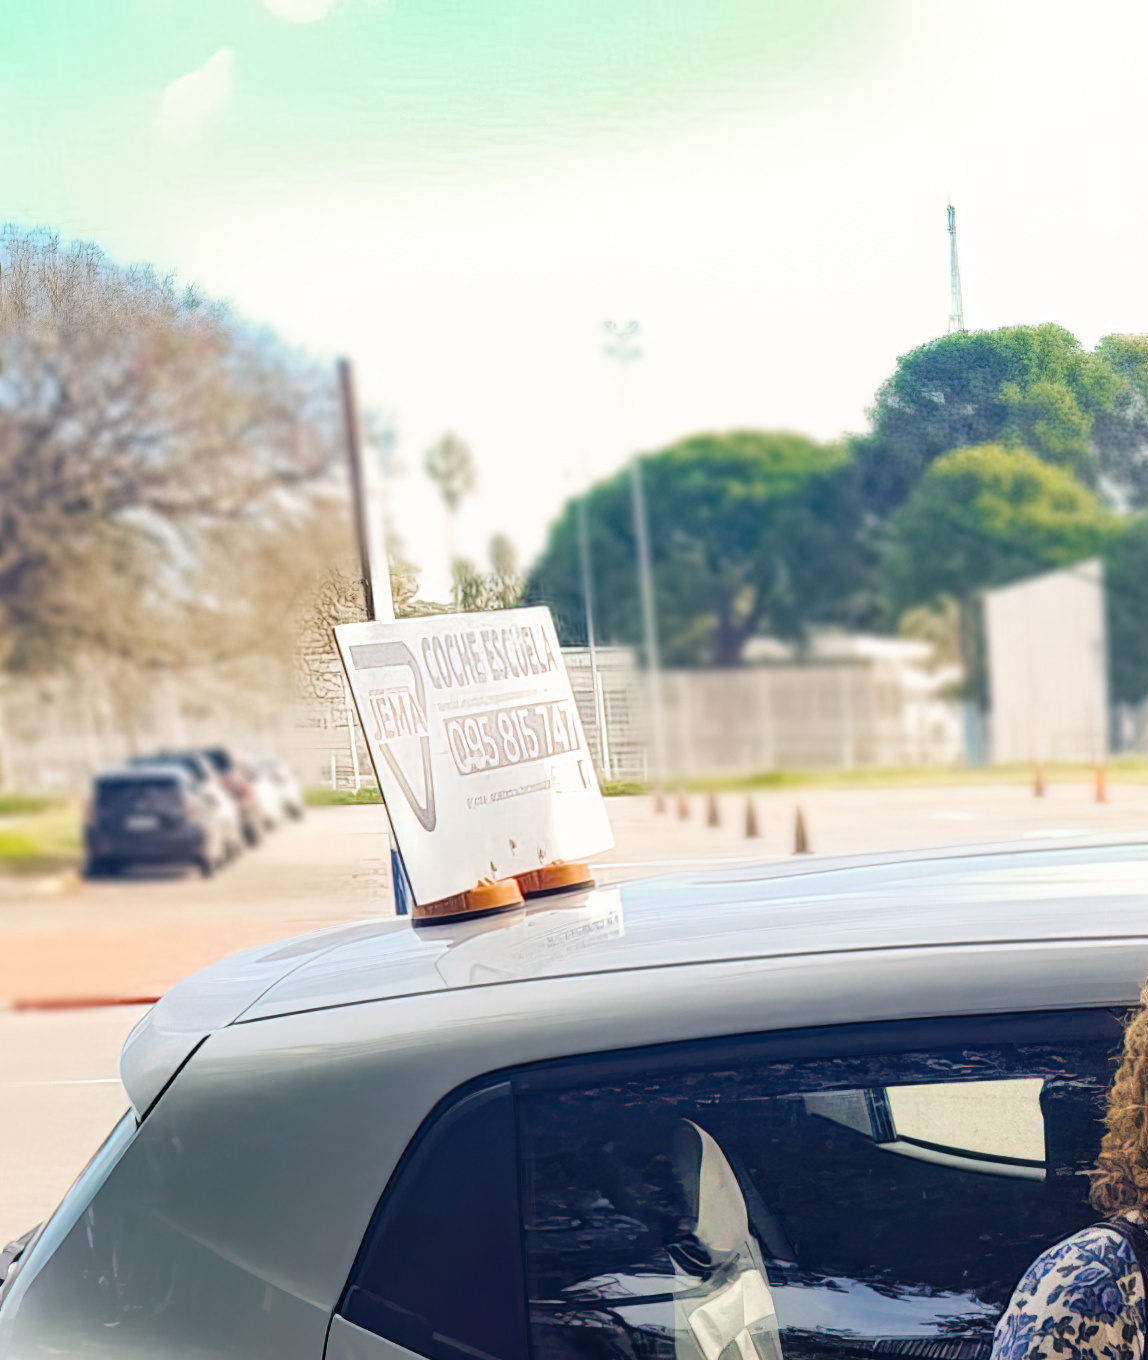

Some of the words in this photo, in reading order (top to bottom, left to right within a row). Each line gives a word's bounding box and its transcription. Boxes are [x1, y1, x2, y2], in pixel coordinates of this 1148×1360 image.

[421, 630, 487, 689] COCHE
[480, 624, 557, 681] ESCUELA
[368, 695, 428, 740] JEMA
[447, 715, 500, 774] 095
[497, 708, 540, 763] 815
[535, 702, 583, 755] 747
